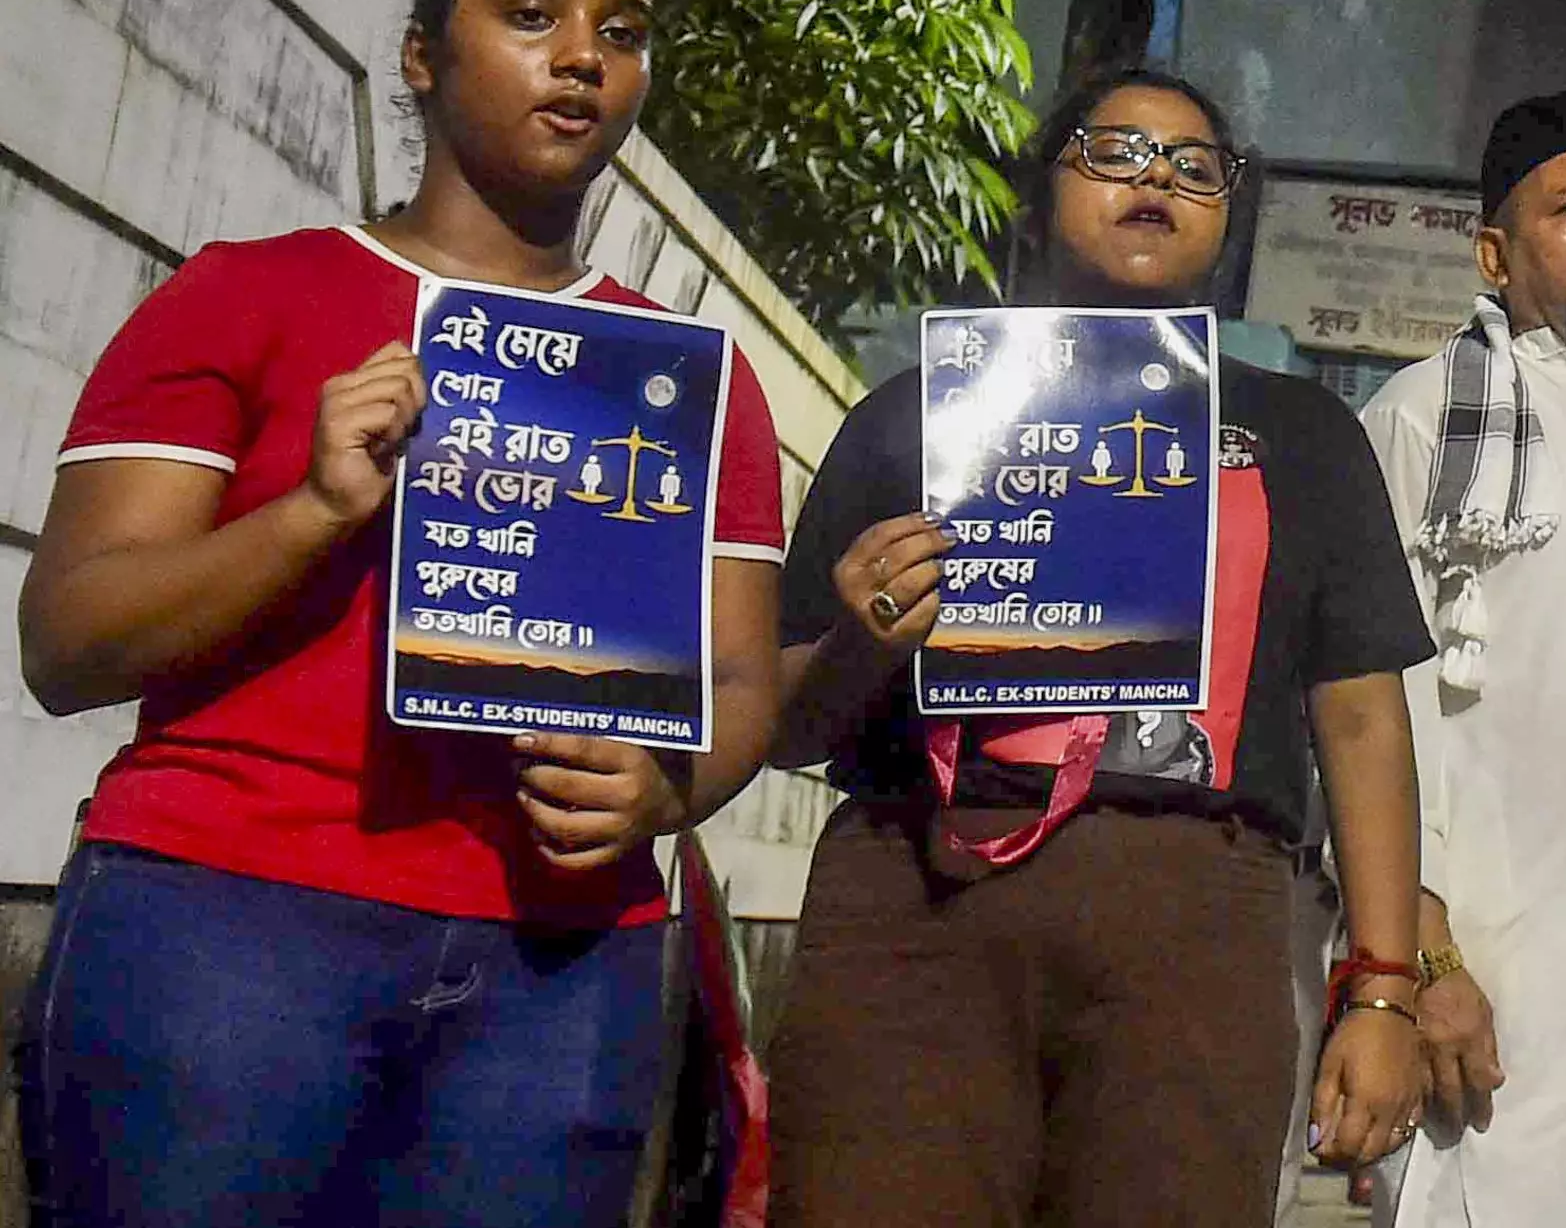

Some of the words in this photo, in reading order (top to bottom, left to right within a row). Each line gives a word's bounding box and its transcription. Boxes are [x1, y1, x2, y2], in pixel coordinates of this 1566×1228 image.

[430, 307, 490, 356] এই
[496, 323, 584, 375] মেয়ে
[431, 369, 505, 408] শোন
[437, 409, 497, 458] এই
[504, 422, 575, 464] রাত
[1018, 419, 1083, 456] রাত
[409, 457, 467, 500] এই
[474, 470, 558, 514] ভোর
[994, 462, 1071, 507] ভোর
[423, 520, 472, 549] যত
[476, 521, 539, 558] খানি
[948, 518, 993, 546] যত
[998, 508, 1055, 546] খানি
[415, 560, 519, 601] পুরুষের
[943, 556, 1038, 592] পুরুষের
[411, 604, 512, 640] ততখানি
[517, 619, 574, 648] তোর
[1032, 604, 1083, 632] তোর
[928, 686, 993, 704] S.N.L.C.
[1118, 682, 1190, 701] MANCHA
[404, 696, 478, 720] S.N.L.C.
[617, 715, 692, 739] MANCHA
